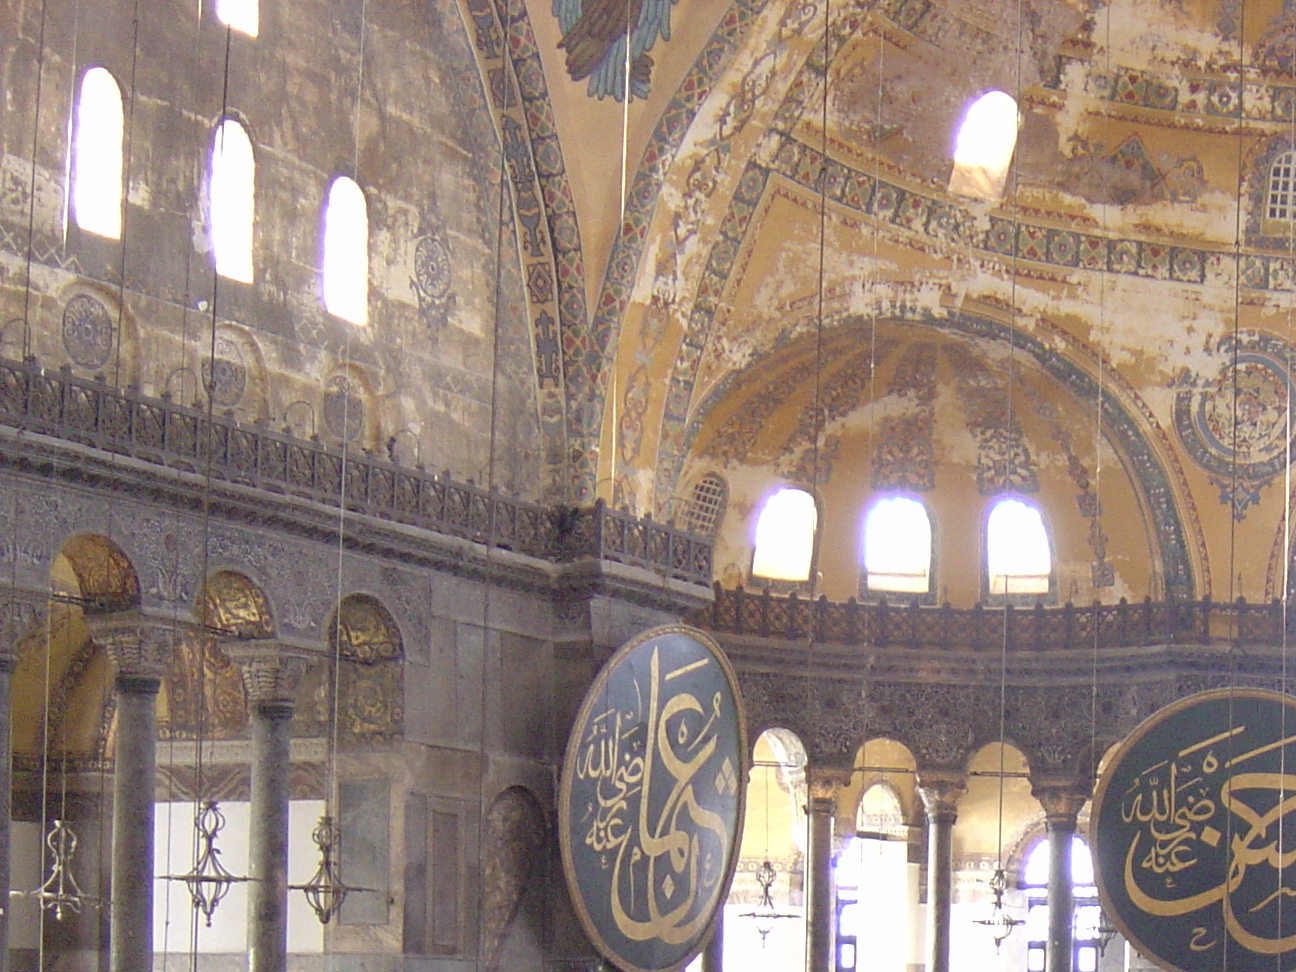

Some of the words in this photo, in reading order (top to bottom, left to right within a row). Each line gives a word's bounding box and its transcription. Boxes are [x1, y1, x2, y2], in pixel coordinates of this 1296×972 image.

[577, 711, 622, 785] الله
[611, 645, 737, 945] عثمان
[1121, 762, 1178, 825] الله
